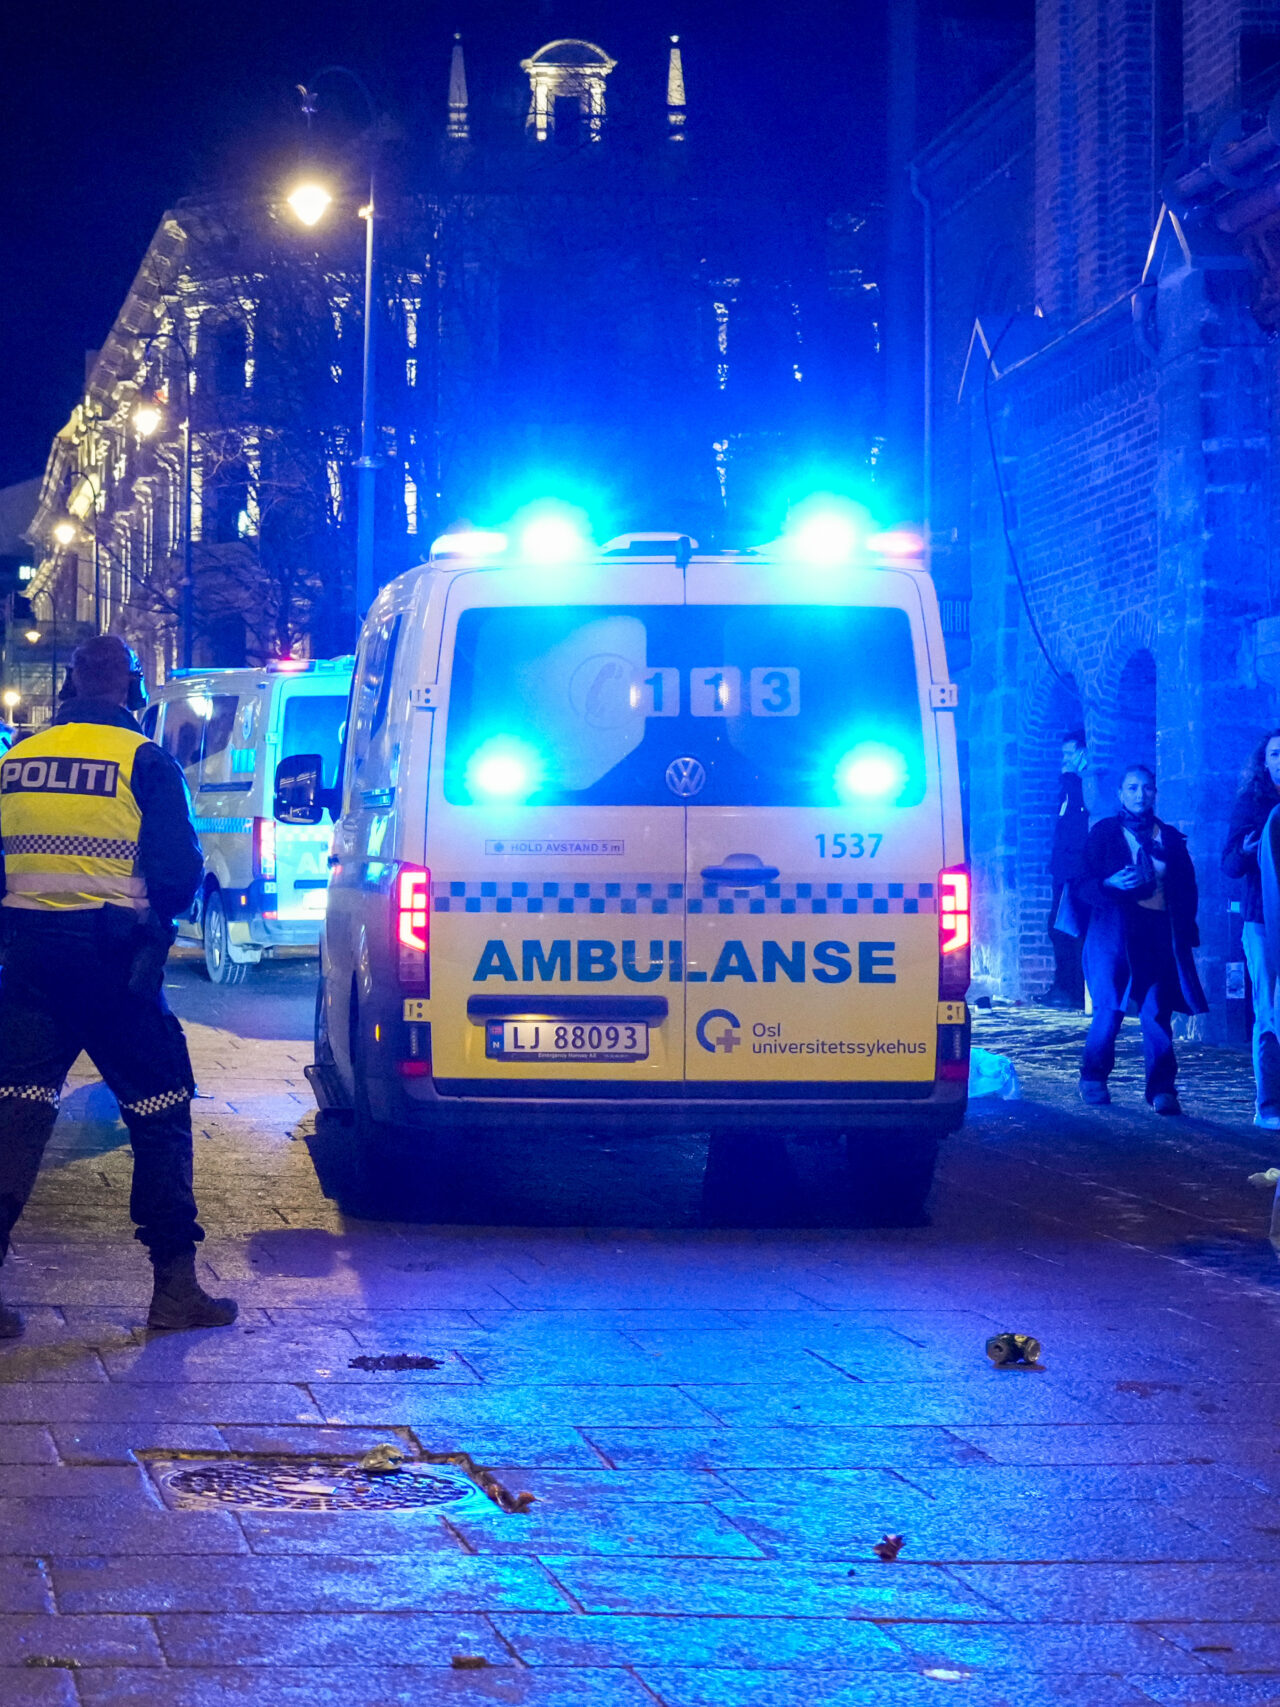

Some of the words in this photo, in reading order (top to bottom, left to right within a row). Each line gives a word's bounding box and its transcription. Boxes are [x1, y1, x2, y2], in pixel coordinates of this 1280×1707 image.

[1, 761, 116, 792] POLITI
[511, 843, 543, 852] HOLD
[545, 843, 599, 852] AVSTAND
[601, 843, 608, 852] 5
[815, 832, 884, 858] 1537
[473, 940, 897, 984] AMBULANSE
[513, 1026, 540, 1049] LJ
[554, 1026, 638, 1050] 88093
[752, 1039, 927, 1057] universitetssykehus
